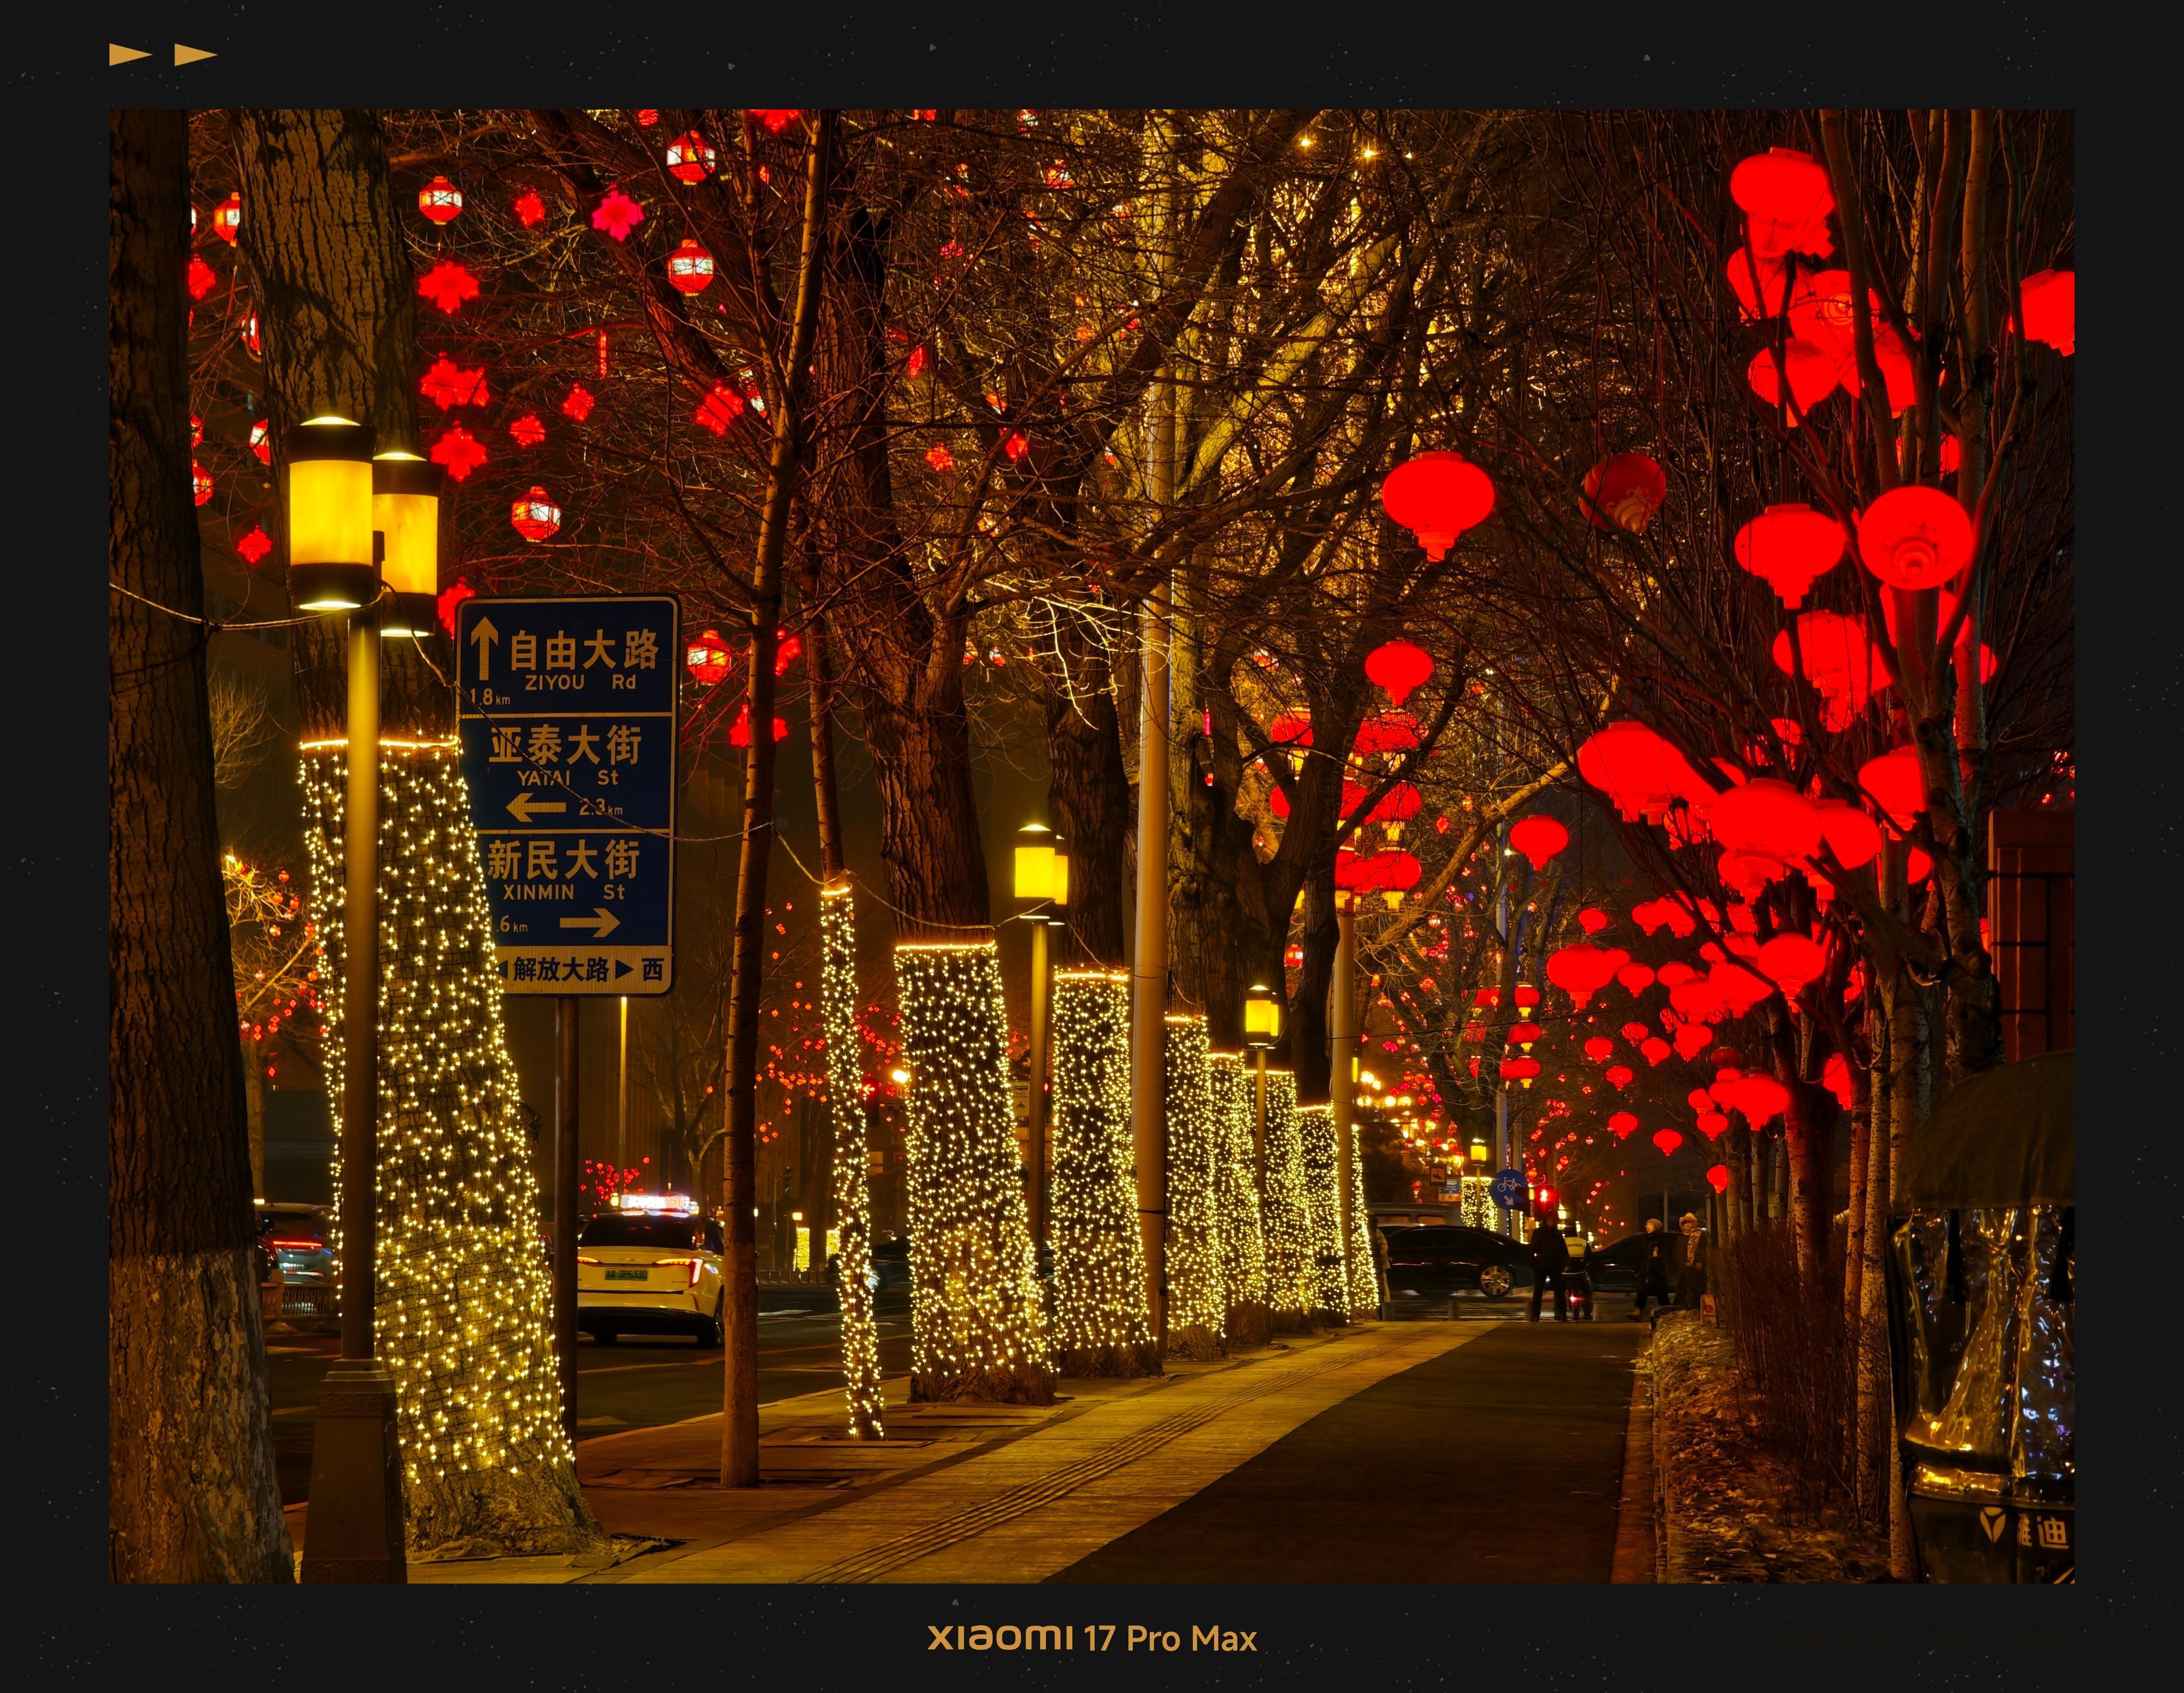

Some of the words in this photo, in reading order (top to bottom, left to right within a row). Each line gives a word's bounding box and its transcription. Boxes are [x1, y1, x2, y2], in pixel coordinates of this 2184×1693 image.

[511, 629, 659, 671] 自由大路
[525, 674, 584, 690] ZIYOU
[612, 674, 636, 690] Rd
[489, 724, 642, 765] 亚泰大街
[517, 770, 570, 786] YATAI
[597, 770, 619, 785] St
[487, 839, 640, 880] 新民大街
[503, 884, 574, 900] XINMIN
[603, 884, 625, 900] St
[513, 956, 610, 982] 解放大路
[642, 958, 664, 981] 西
